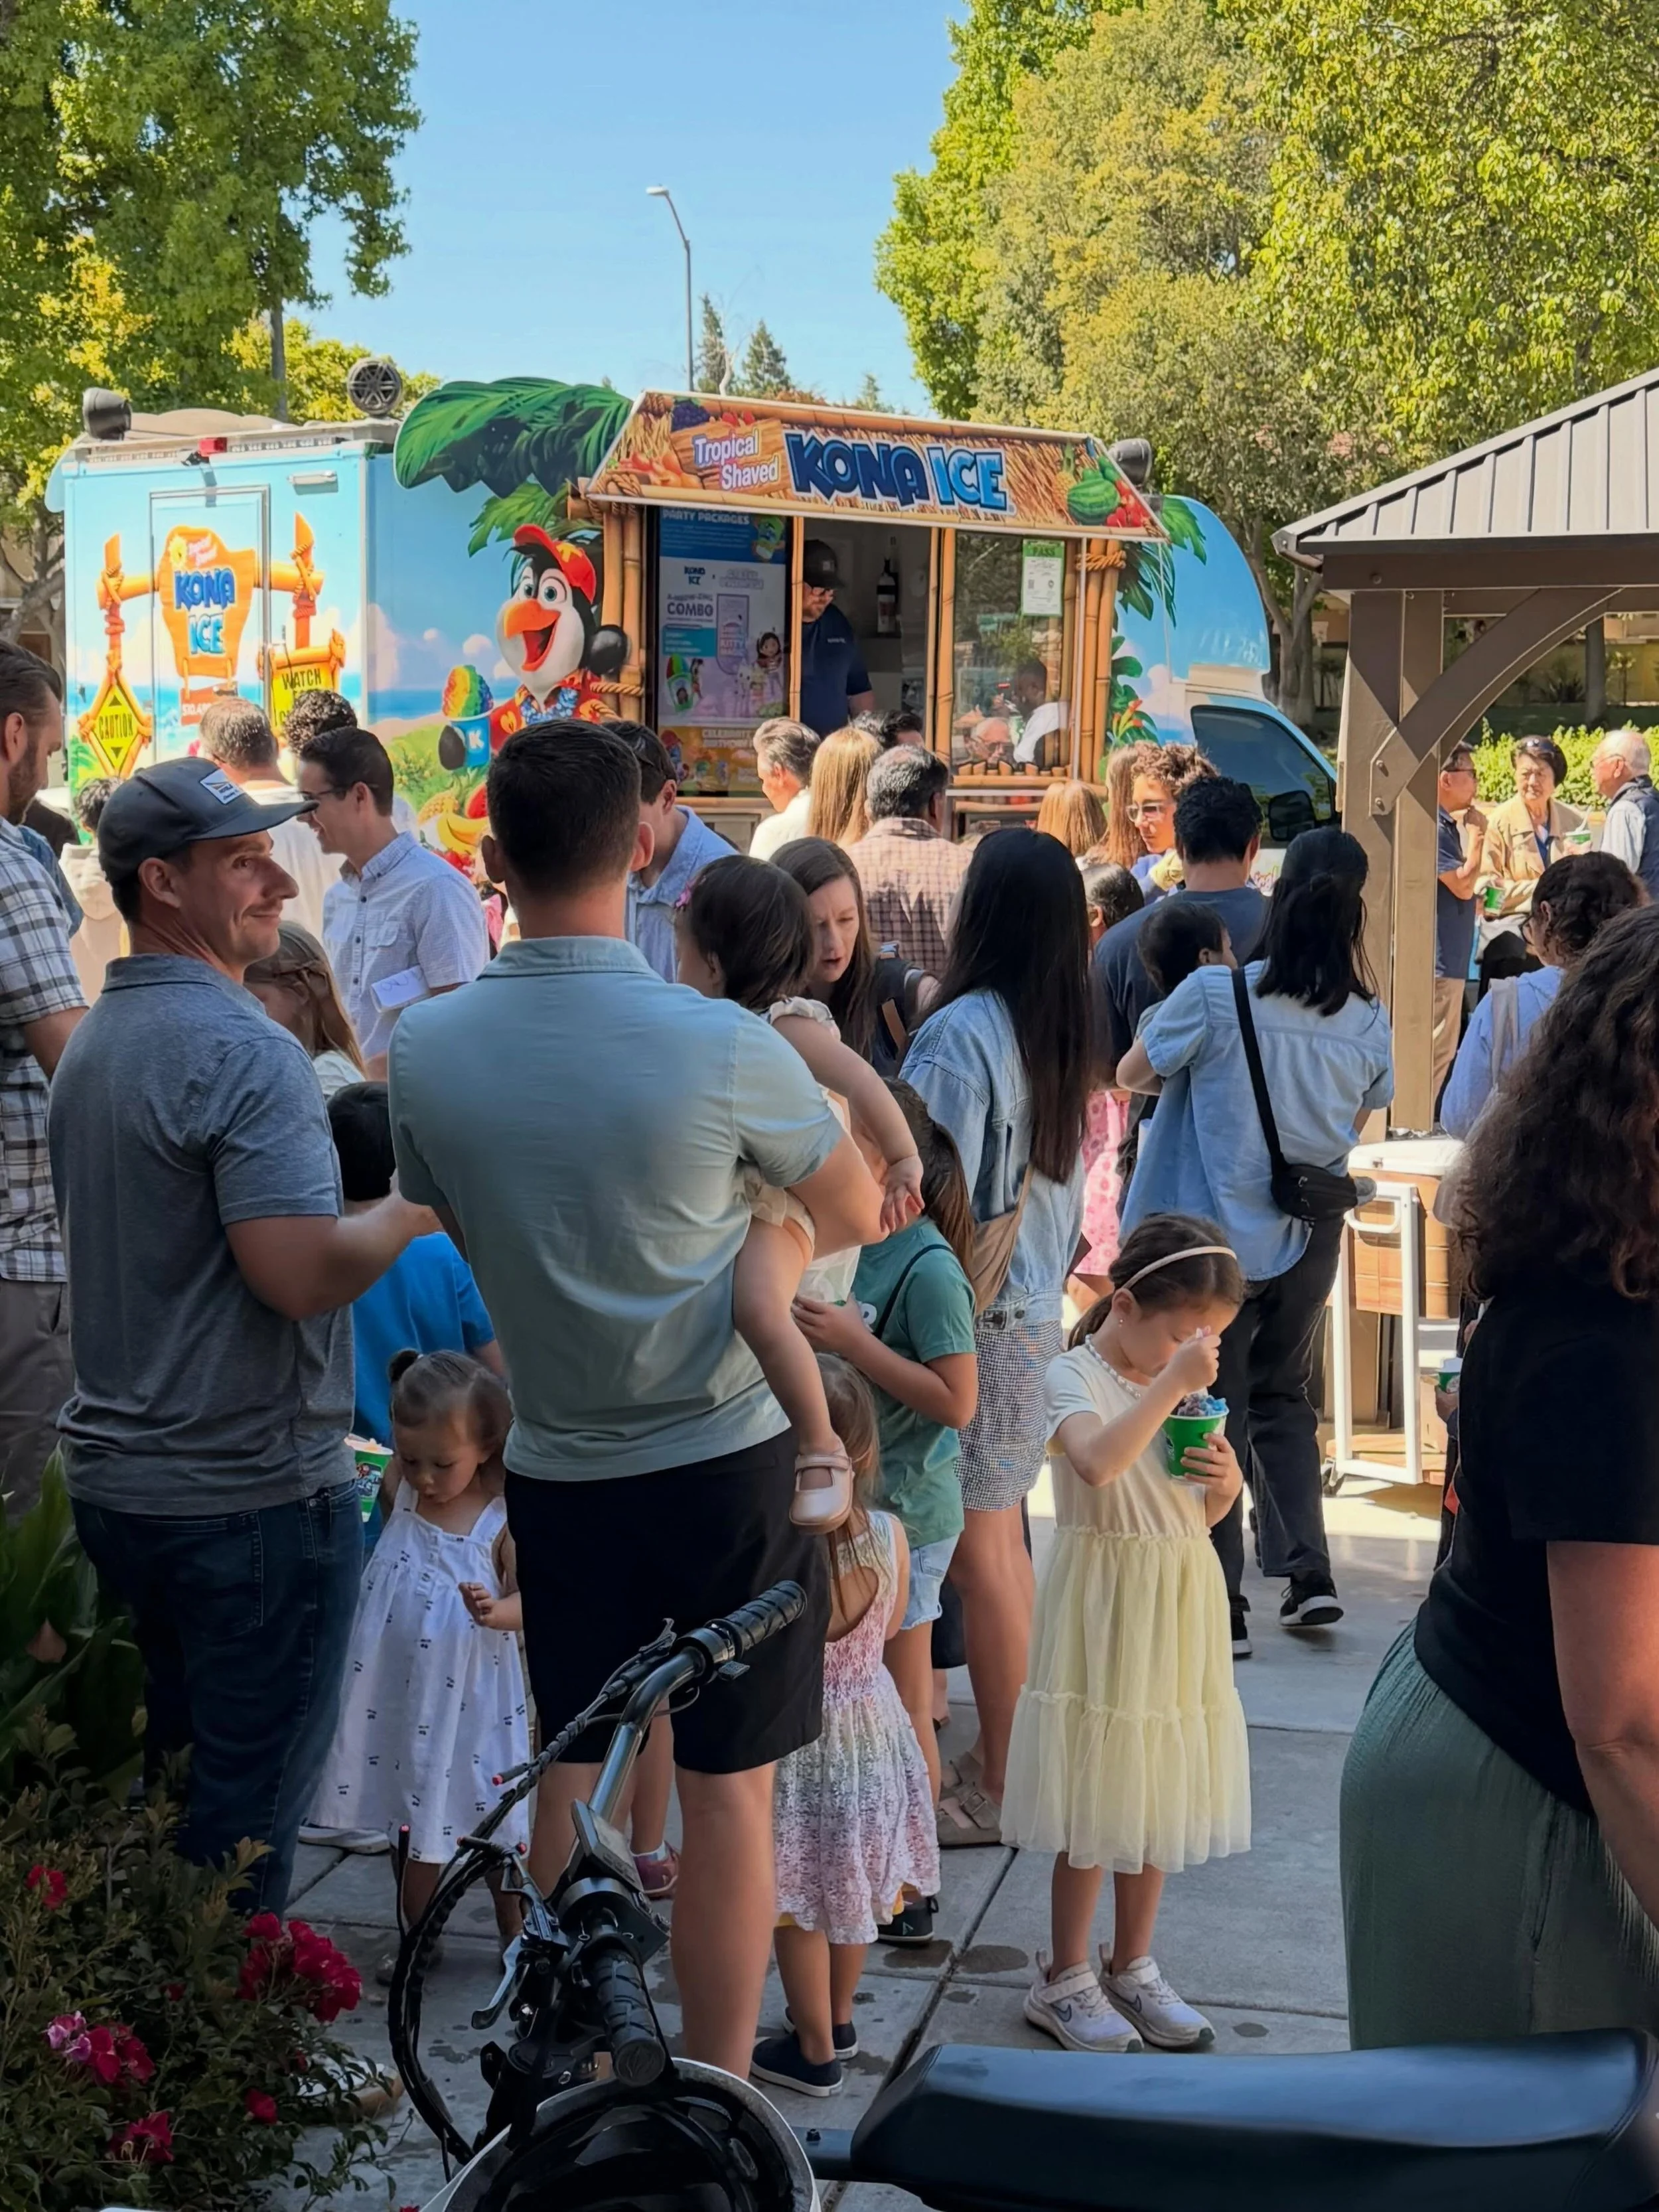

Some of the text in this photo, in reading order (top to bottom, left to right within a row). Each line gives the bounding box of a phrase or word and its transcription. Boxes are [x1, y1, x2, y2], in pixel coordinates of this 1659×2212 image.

[693, 428, 760, 465] Tropical
[721, 455, 779, 490] Shaved
[785, 433, 1007, 511] KONA ICE
[663, 509, 750, 525] PARTY PACKAGES
[175, 568, 235, 611] KONA
[667, 602, 713, 617] COMBO
[188, 613, 224, 654] ICE
[282, 668, 322, 690] WATCH
[99, 712, 133, 740] CAUTION
[469, 730, 484, 749] K
